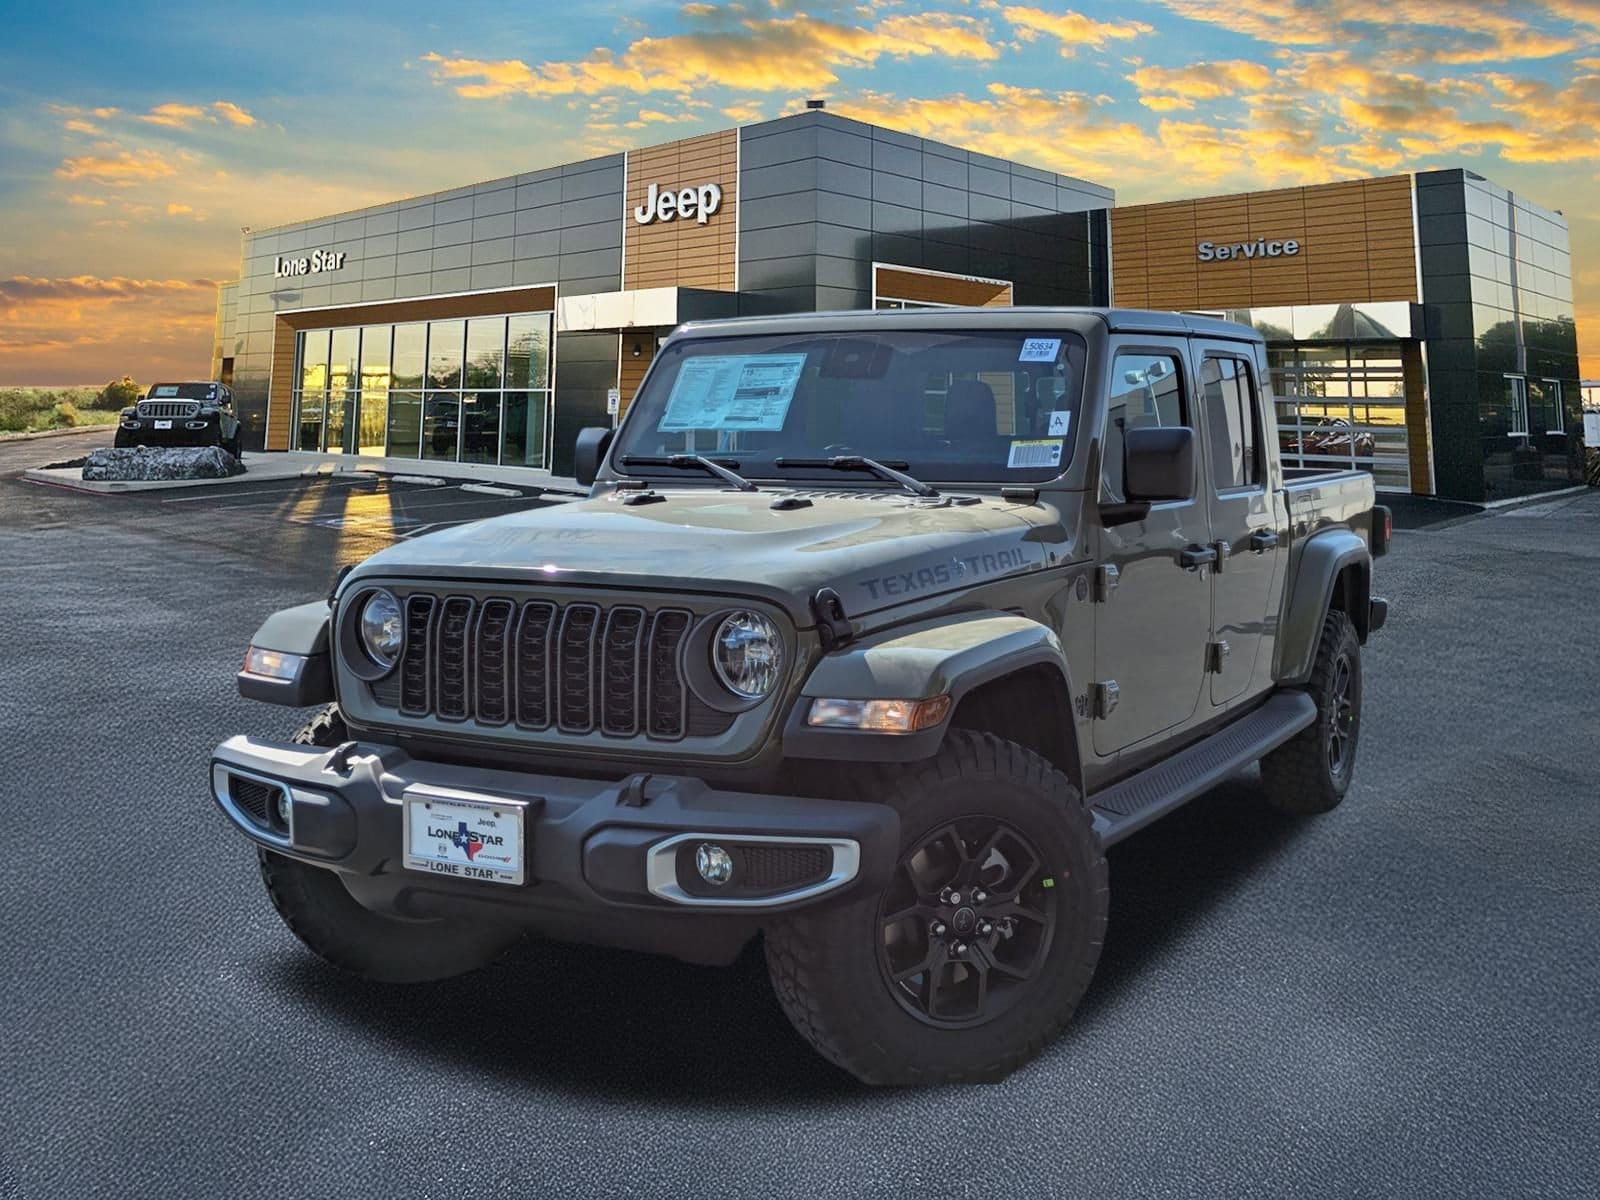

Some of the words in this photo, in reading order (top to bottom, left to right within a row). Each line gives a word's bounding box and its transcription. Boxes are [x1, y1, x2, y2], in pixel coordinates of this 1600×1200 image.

[634, 183, 722, 225] Jeep
[1198, 237, 1299, 261] Service
[274, 256, 309, 278] Lone
[311, 249, 346, 273] Star
[858, 563, 949, 600] TEXAS
[965, 547, 1031, 577] TRAIL
[477, 818, 496, 828] Jeep
[428, 826, 460, 840] LONE
[470, 831, 503, 845] STAR
[430, 862, 459, 874] LONE
[464, 867, 493, 879] STAR
